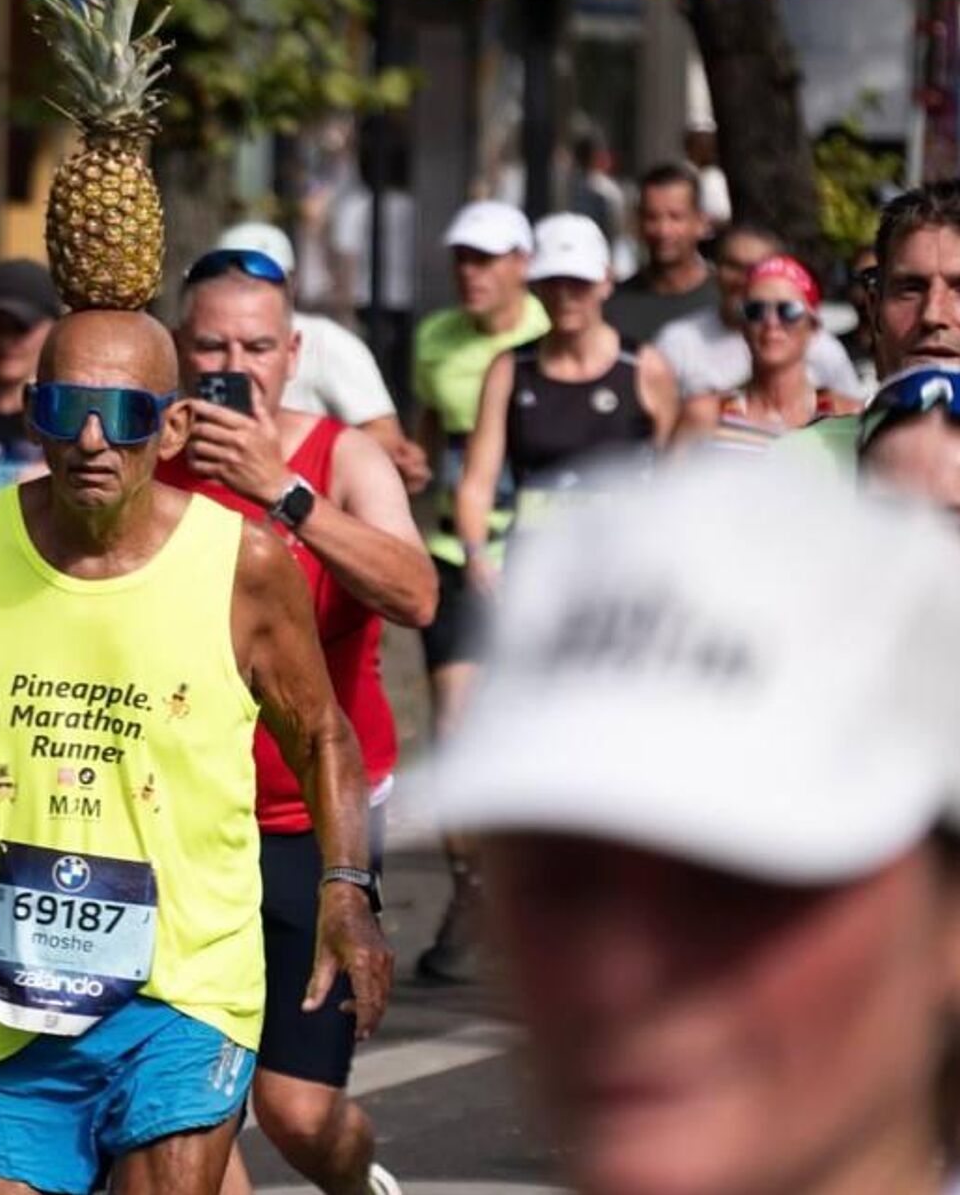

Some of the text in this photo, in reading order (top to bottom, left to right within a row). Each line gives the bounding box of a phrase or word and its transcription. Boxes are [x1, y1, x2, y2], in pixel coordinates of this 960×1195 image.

[10, 674, 152, 712] Pineapple.
[10, 705, 146, 741] Marathon.
[30, 735, 126, 765] Runner
[12, 892, 126, 934] 69187
[31, 931, 94, 953] moshe
[13, 969, 104, 997] zalando
